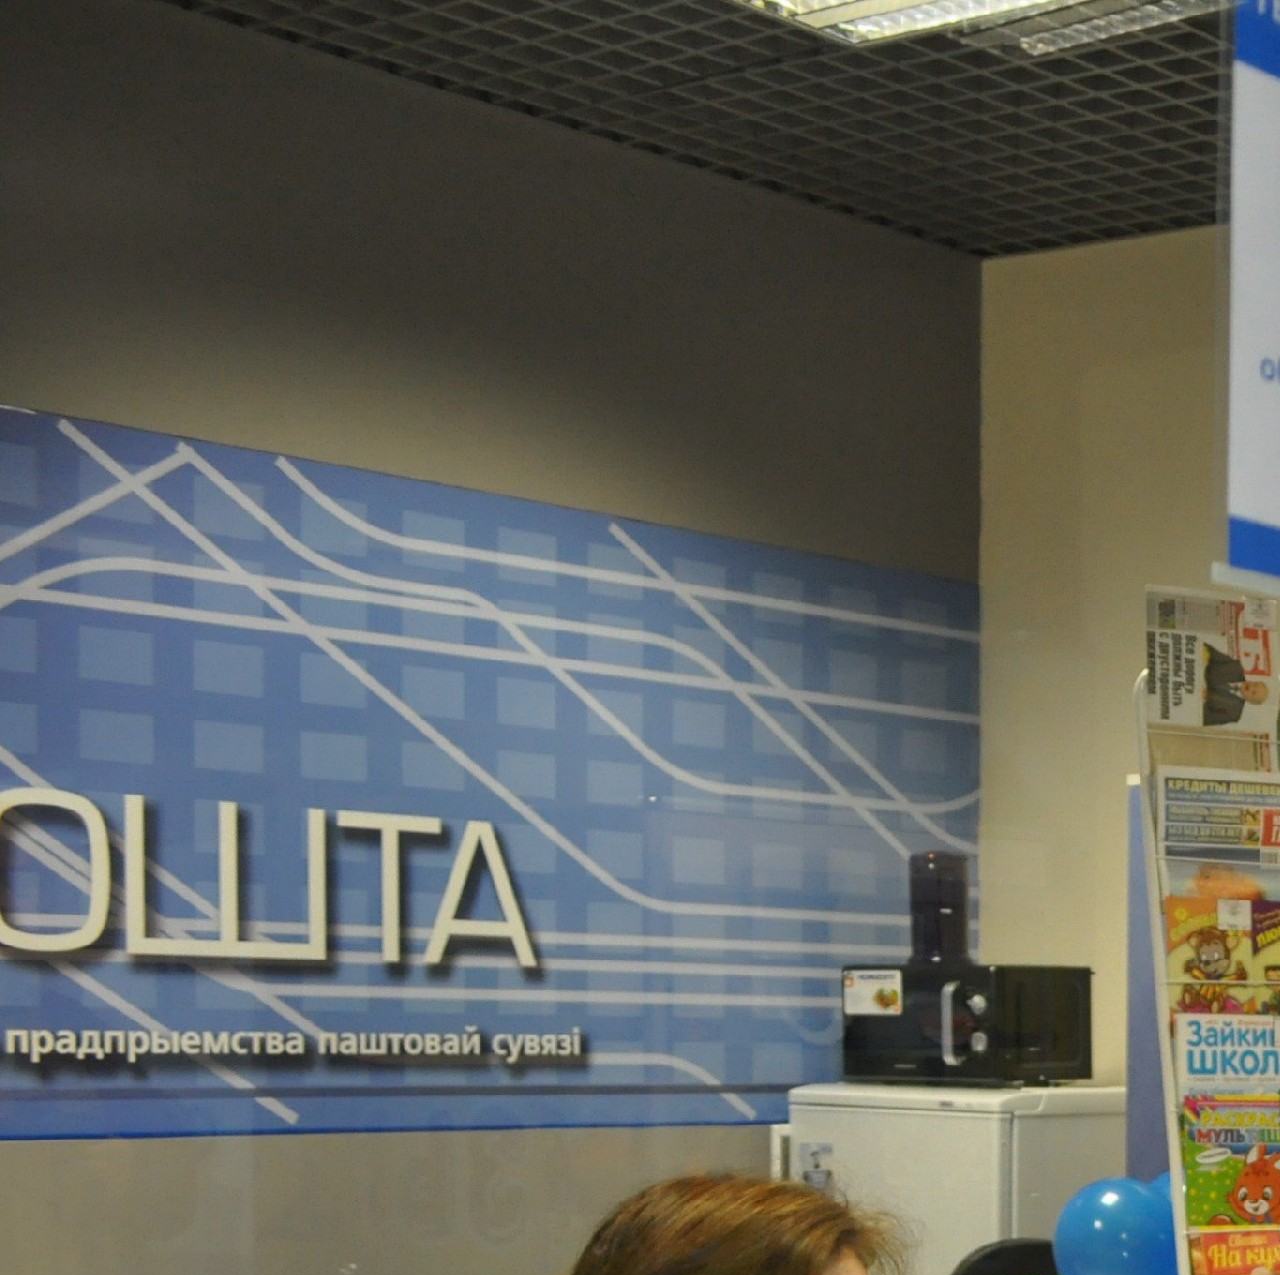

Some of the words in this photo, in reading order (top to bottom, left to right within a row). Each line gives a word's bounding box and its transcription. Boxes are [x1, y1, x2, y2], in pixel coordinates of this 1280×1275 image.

[5, 1027, 303, 1061] прадпрыемства
[318, 1025, 482, 1058] паштовай
[491, 1026, 582, 1063] сувязі
[1200, 1111, 1280, 1127] РАСКРАС
[1208, 1243, 1243, 1269] На
